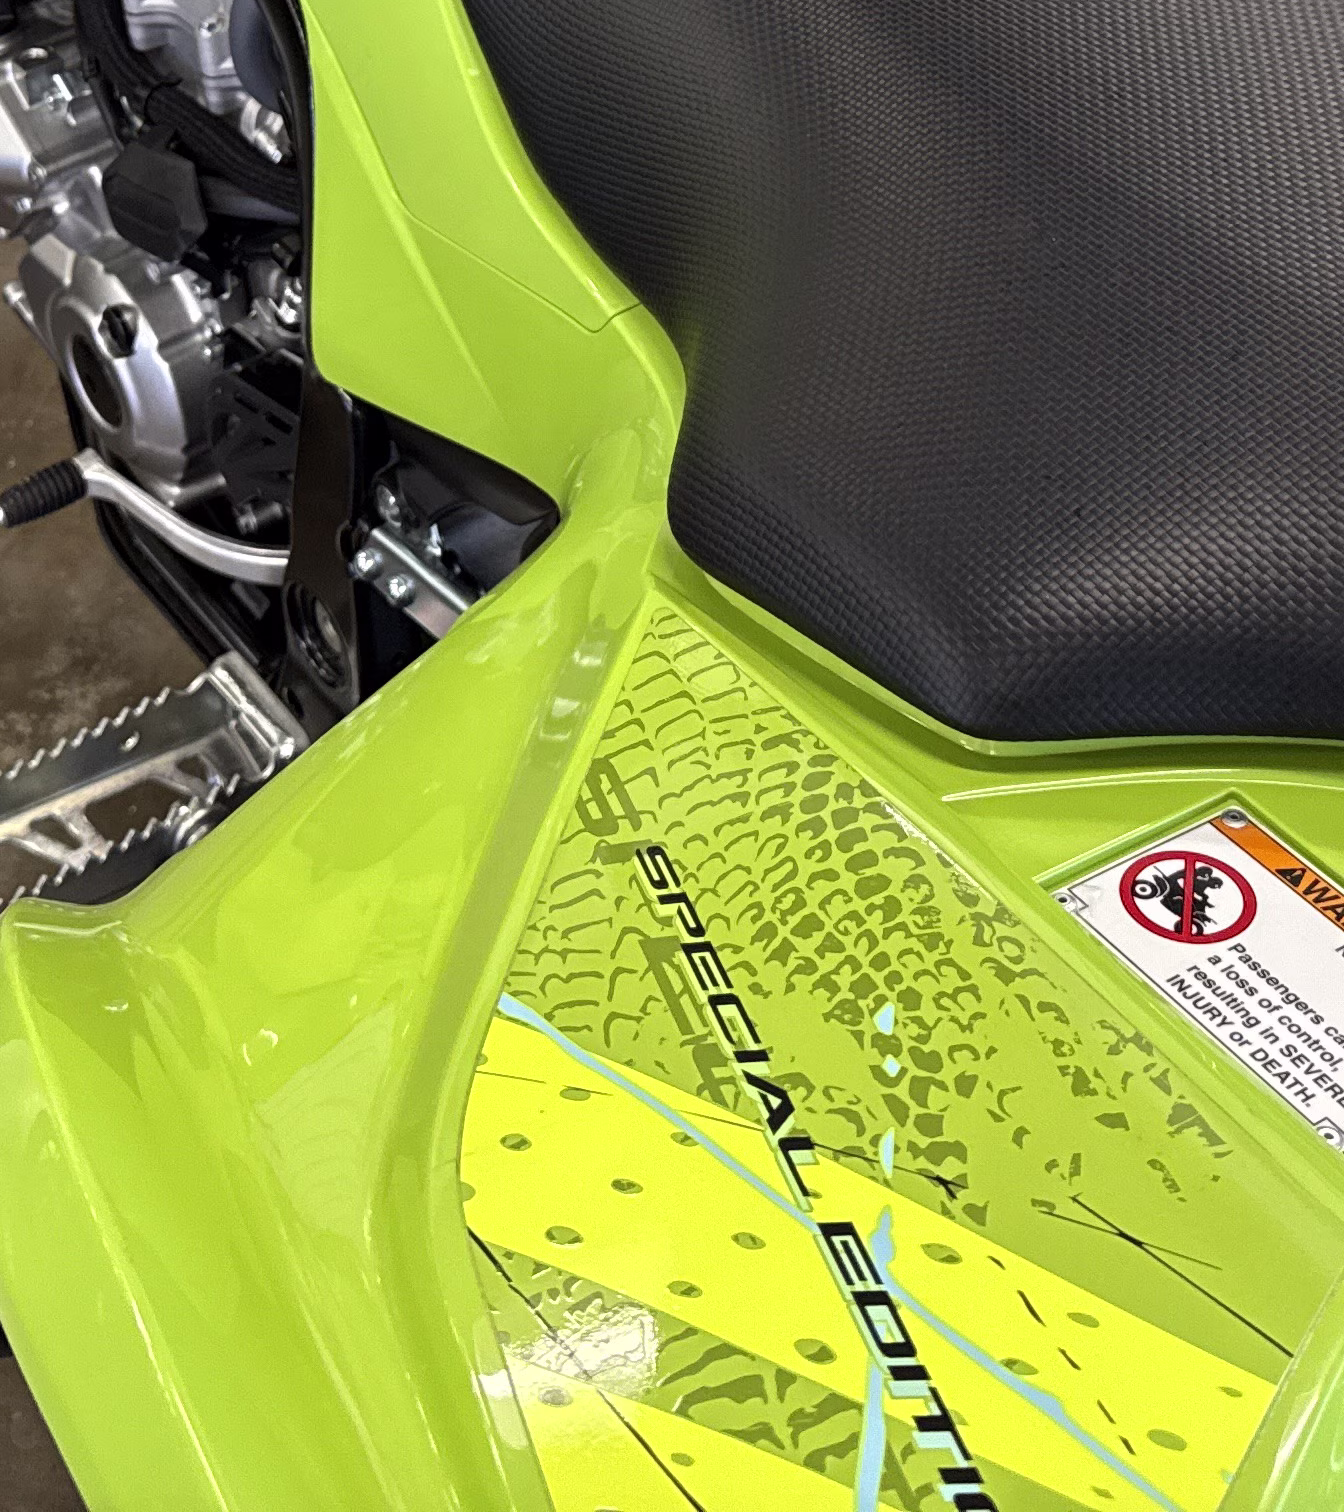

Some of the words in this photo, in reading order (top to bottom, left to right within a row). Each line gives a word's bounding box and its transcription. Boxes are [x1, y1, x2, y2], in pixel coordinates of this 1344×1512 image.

[1166, 974, 1236, 1030] INJURY
[1229, 1030, 1252, 1049] or
[1249, 1048, 1317, 1108] DEATH.
[1187, 964, 1261, 1029] resulting
[1259, 1026, 1280, 1046] in
[1207, 953, 1221, 966] a
[1219, 964, 1258, 997] loss
[1258, 997, 1283, 1018] of
[1278, 1015, 1343, 1072] control,
[1227, 943, 1325, 1026] Passengers
[632, 844, 818, 1202] SPECIAL
[814, 1220, 1000, 1512] EDITI
